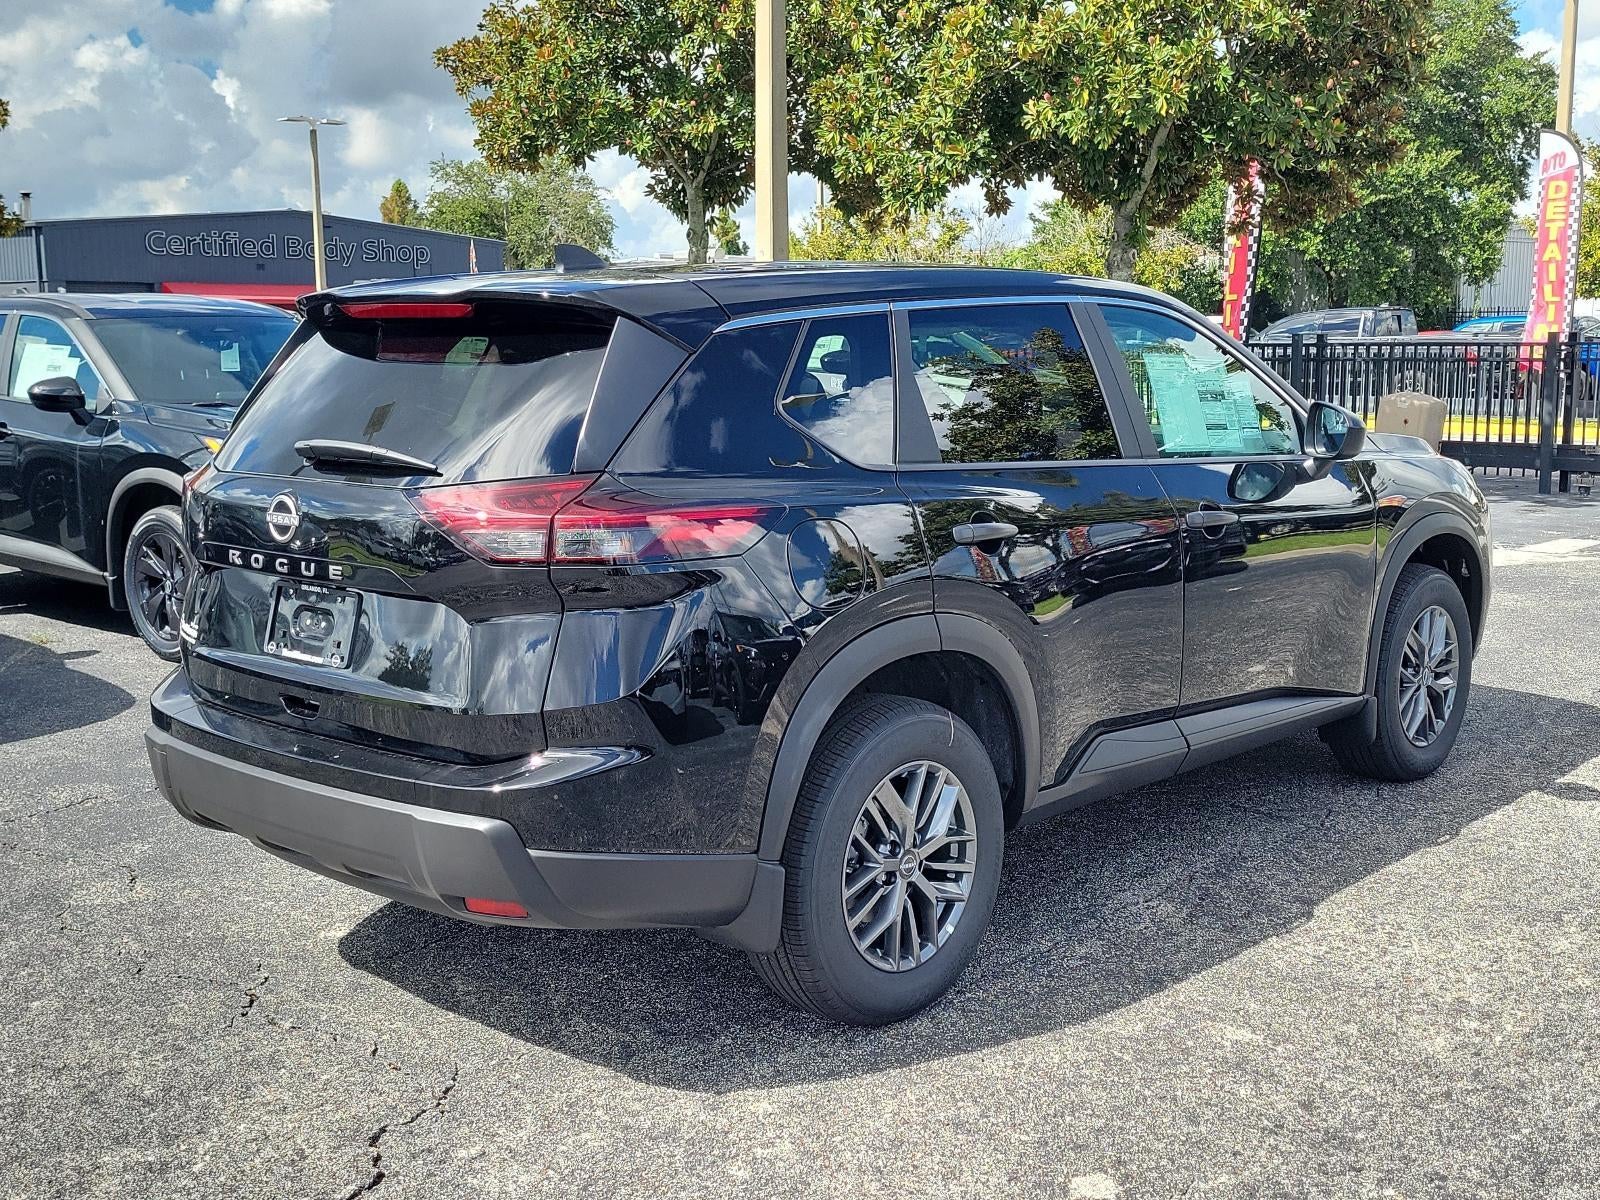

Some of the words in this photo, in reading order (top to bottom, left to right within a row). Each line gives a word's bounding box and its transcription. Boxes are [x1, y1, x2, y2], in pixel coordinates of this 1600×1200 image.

[145, 230, 278, 258] Certified
[284, 235, 357, 267] Body
[362, 238, 431, 270] Shop
[266, 512, 299, 527] NISSAN
[228, 549, 343, 581] ROGUE
